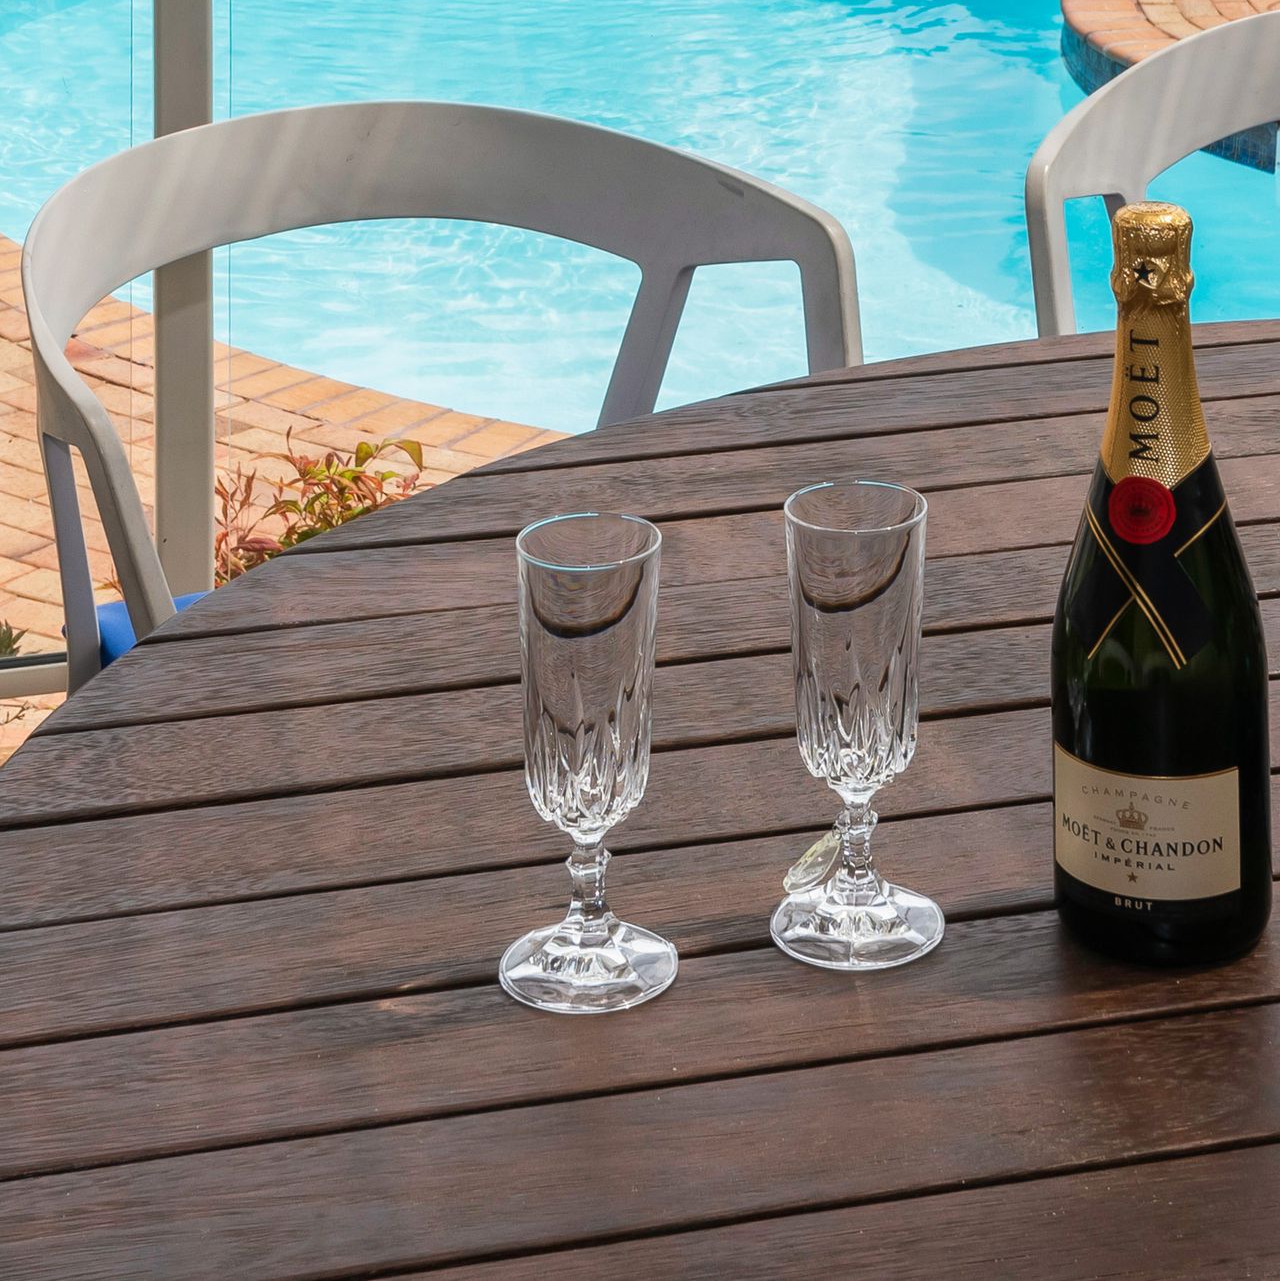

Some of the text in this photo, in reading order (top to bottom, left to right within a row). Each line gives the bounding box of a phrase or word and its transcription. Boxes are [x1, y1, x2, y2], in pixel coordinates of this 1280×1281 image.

[1125, 329, 1160, 461] MOËT
[1081, 785, 1192, 810] CHAMPAGNE
[1105, 837, 1116, 851] &
[1120, 837, 1223, 857] CHANDON
[1094, 851, 1176, 871] IMPÉRIAL
[1114, 896, 1153, 911] BRUT
